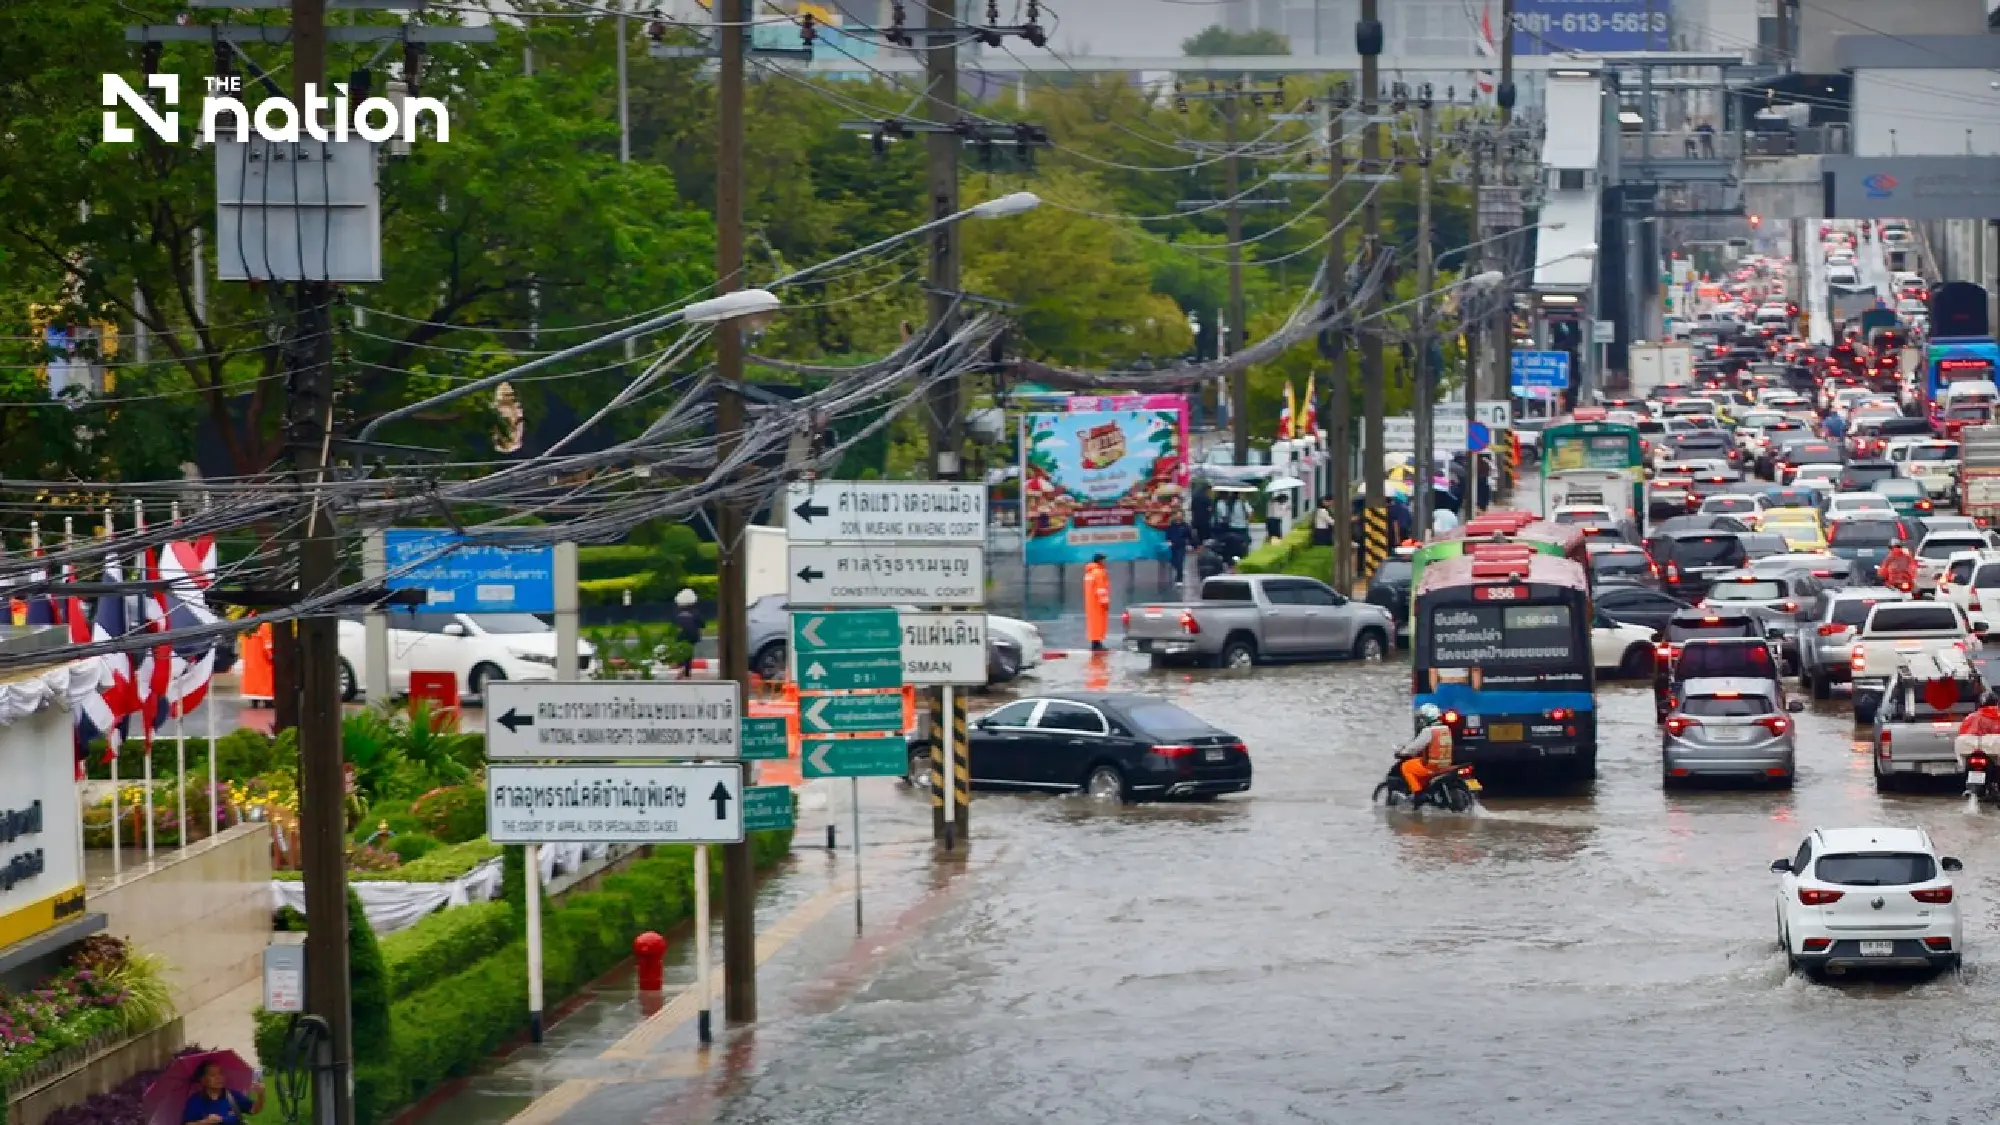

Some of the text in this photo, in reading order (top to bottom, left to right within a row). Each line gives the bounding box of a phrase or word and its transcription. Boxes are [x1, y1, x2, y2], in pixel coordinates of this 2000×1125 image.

[865, 521, 903, 536] MUEANG
[950, 521, 981, 536] COURT
[837, 553, 970, 578] ศาลรัฐธรรมนูญ
[831, 586, 976, 597] CONSTITUTIONAL COURT
[900, 618, 981, 646] รแผ่นดิน
[538, 728, 576, 744] NATIONAL
[577, 728, 605, 744] HUMAN
[606, 728, 633, 744] RIGHTS
[697, 728, 733, 744] THAILAND
[502, 819, 679, 832] THE COURT OF APPEAL FOR SPECIALIZED CASES
